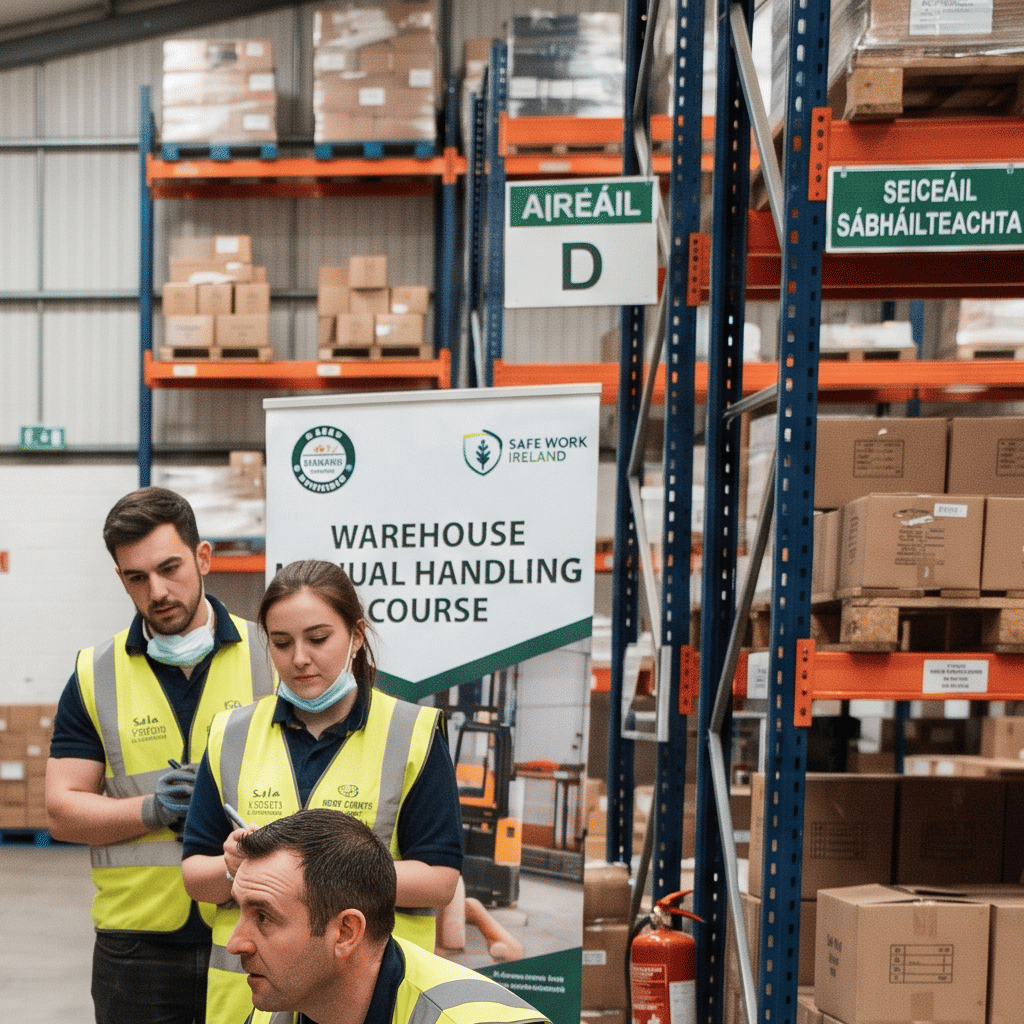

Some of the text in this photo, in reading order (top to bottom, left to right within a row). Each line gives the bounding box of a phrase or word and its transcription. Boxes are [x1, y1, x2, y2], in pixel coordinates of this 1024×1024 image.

[883, 171, 977, 204] SEICEÁIL
[836, 206, 1023, 237] SÁBHÁILTEACHTA
[562, 242, 603, 291] D
[508, 450, 567, 463] IRELAND
[509, 435, 588, 450] SAFE WORK
[331, 520, 526, 549] WAREHOUSE
[415, 558, 583, 586] HANDLING
[368, 597, 489, 624] COURSE
